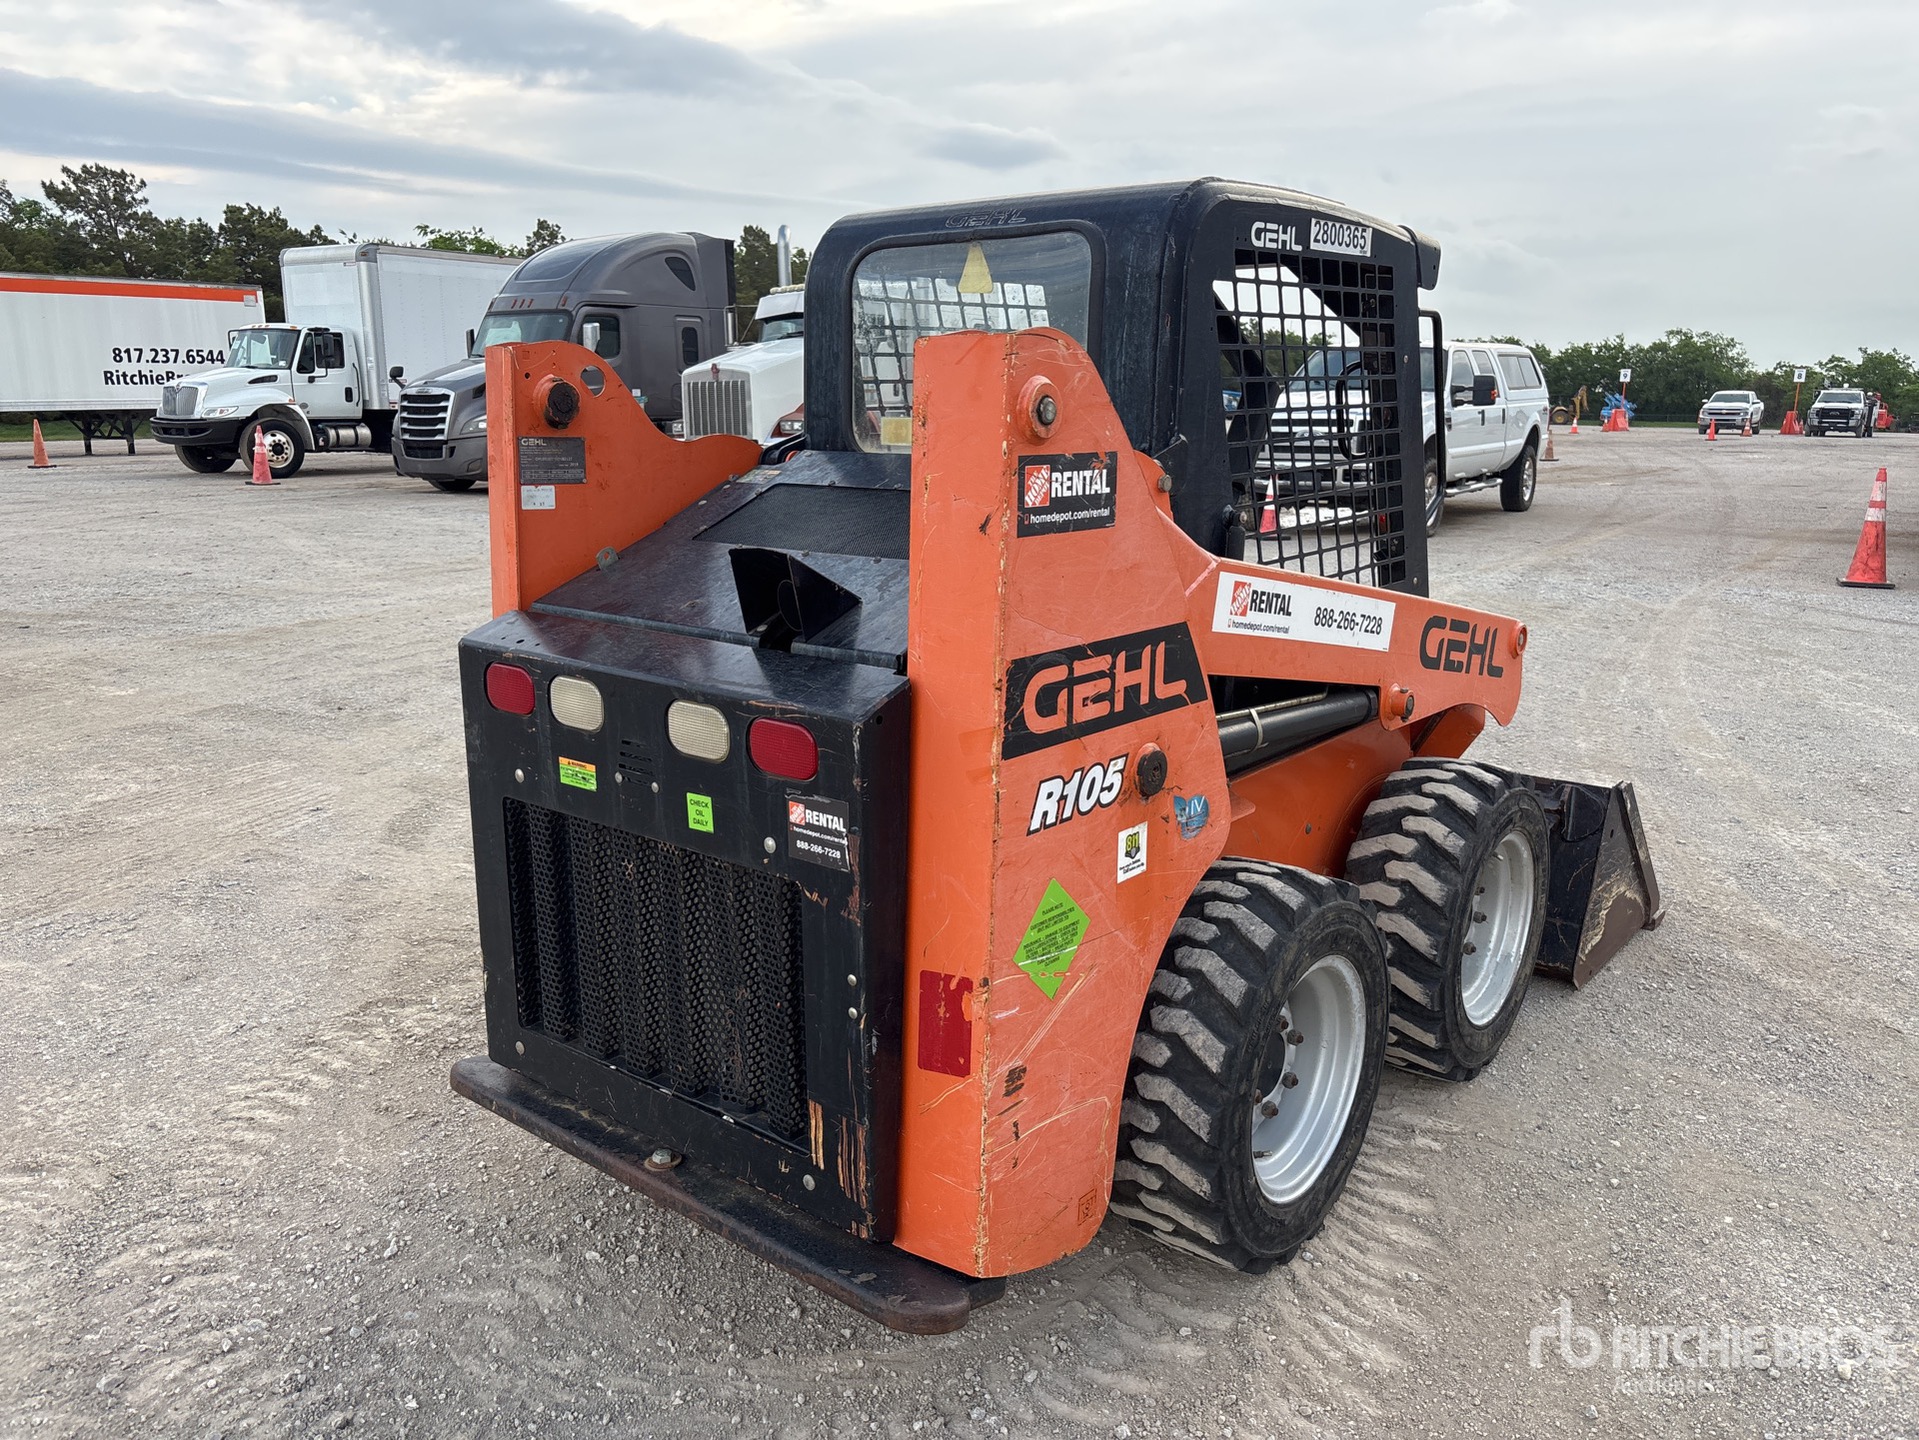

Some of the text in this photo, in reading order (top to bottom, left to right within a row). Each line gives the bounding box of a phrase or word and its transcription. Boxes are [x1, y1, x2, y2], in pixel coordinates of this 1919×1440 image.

[945, 208, 1027, 228] GEHL
[1251, 221, 1302, 251] GEHL
[1313, 220, 1367, 250] 2800365
[112, 347, 226, 365] 817.237.6544
[1796, 372, 1803, 380] 8
[521, 438, 547, 446] GEHL
[1051, 469, 1110, 498] RENTAL
[1030, 506, 1110, 523] homedepot.com/rental
[1249, 589, 1292, 616] RENTAL
[1232, 620, 1290, 634] homedepot.com/rental
[1314, 606, 1383, 635] 888-266-7228
[1419, 615, 1504, 678] GEHL
[1023, 641, 1187, 734] GEHL
[690, 798, 709, 809] CHECK
[1027, 753, 1129, 836] R105
[692, 817, 708, 826] DAILY
[695, 809, 705, 817] OIL
[805, 808, 847, 832] RENTAL
[796, 840, 841, 859] 888-266-7228
[1126, 831, 1139, 851] 811
